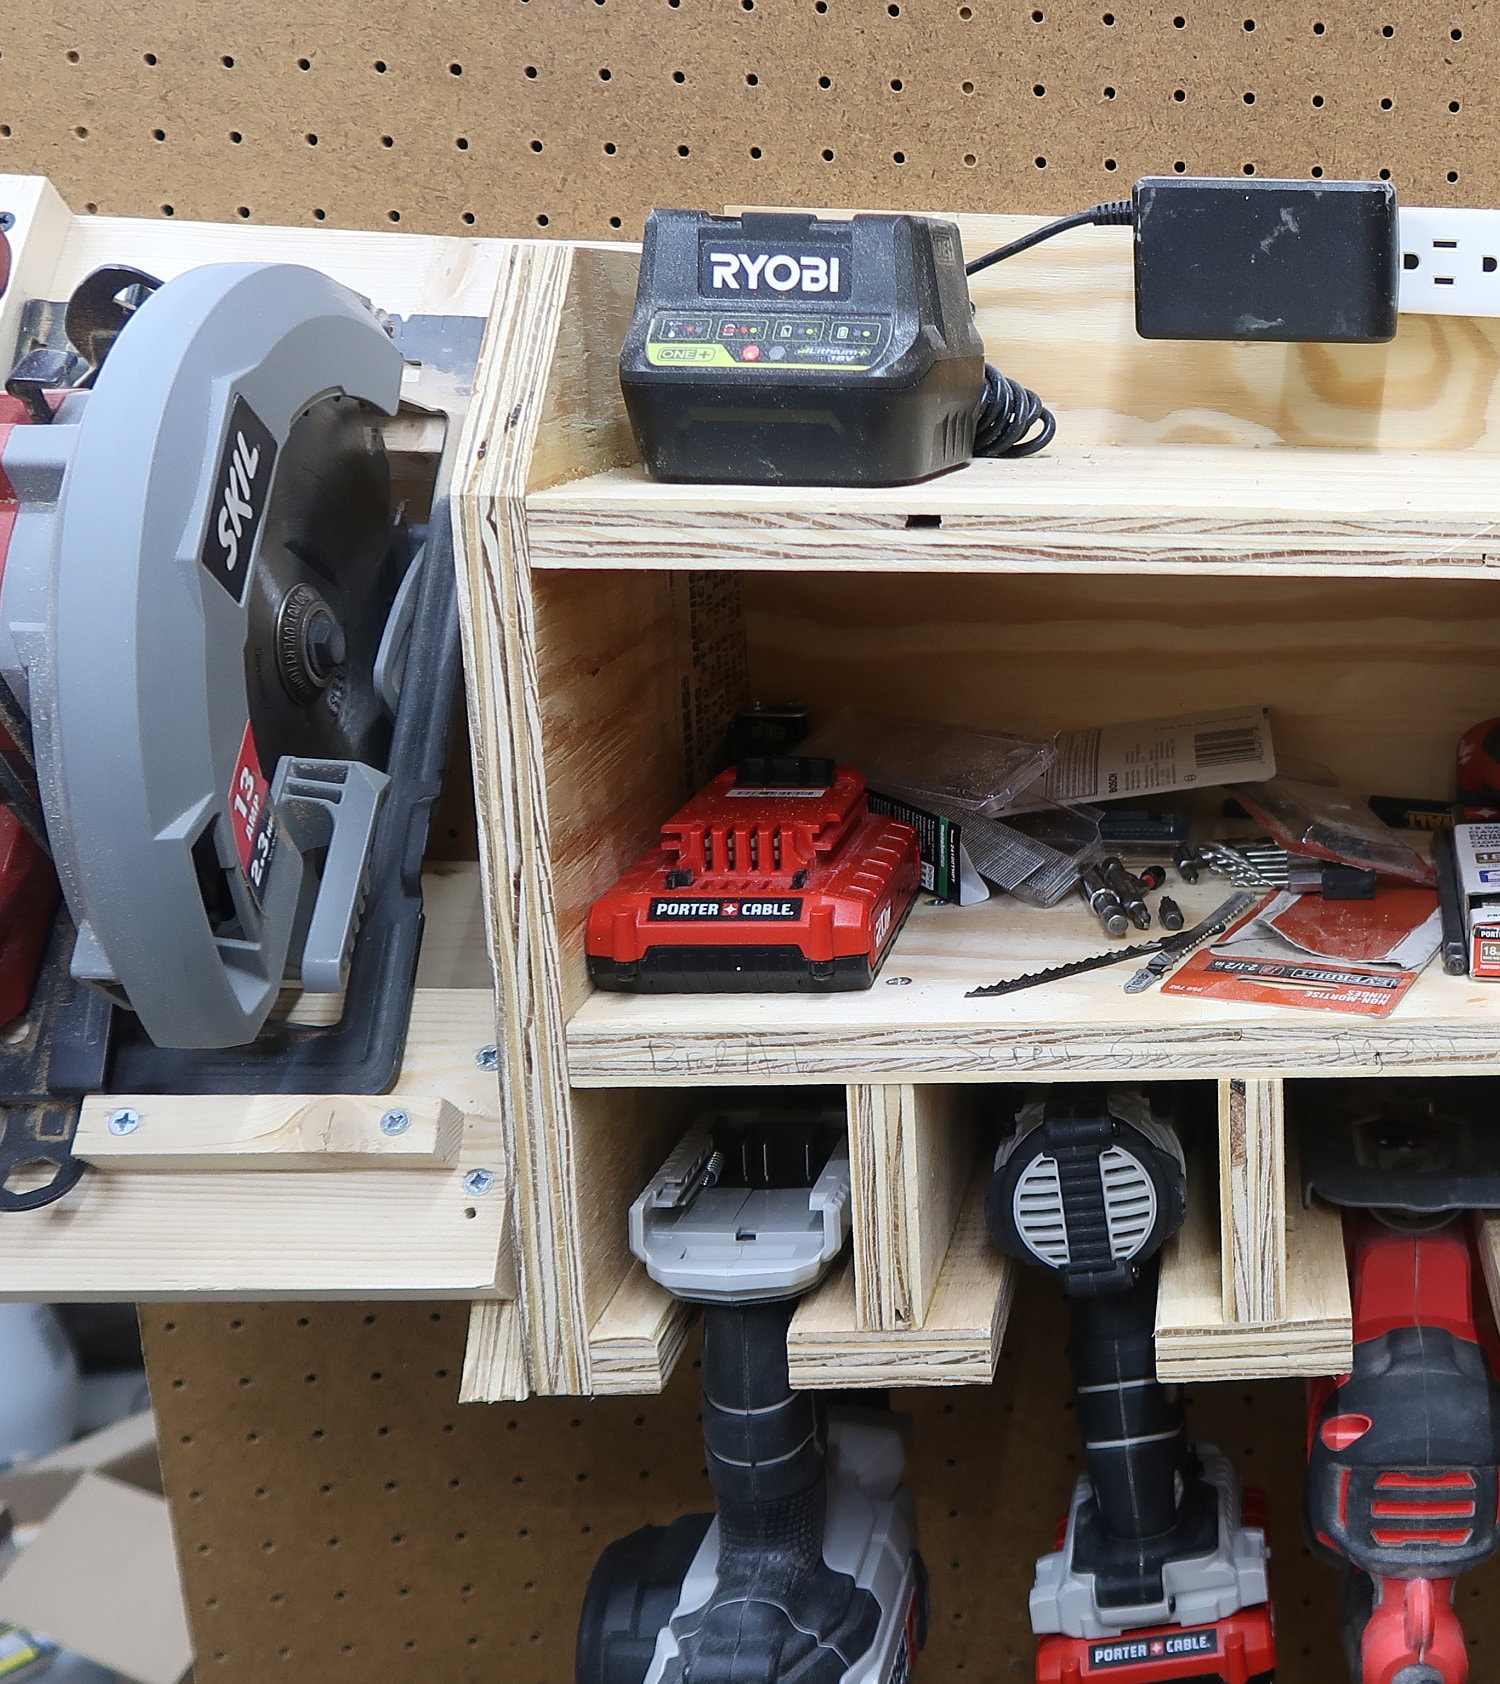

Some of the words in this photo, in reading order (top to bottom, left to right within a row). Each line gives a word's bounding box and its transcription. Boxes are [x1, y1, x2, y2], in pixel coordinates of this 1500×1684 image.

[710, 253, 839, 293] RYOBI
[661, 349, 711, 360] ONE+
[216, 431, 260, 571] SKIL
[235, 766, 255, 818] 13
[1109, 772, 1118, 794] BOSCH
[244, 794, 261, 841] AMP
[251, 831, 269, 887] 2.3
[656, 903, 719, 916] PORTER
[1224, 962, 1258, 971] 2-1/2
[1304, 991, 1388, 1006] NON-MORTISE
[1347, 990, 1392, 1000] HINGES
[1095, 1644, 1147, 1663] PORTER
